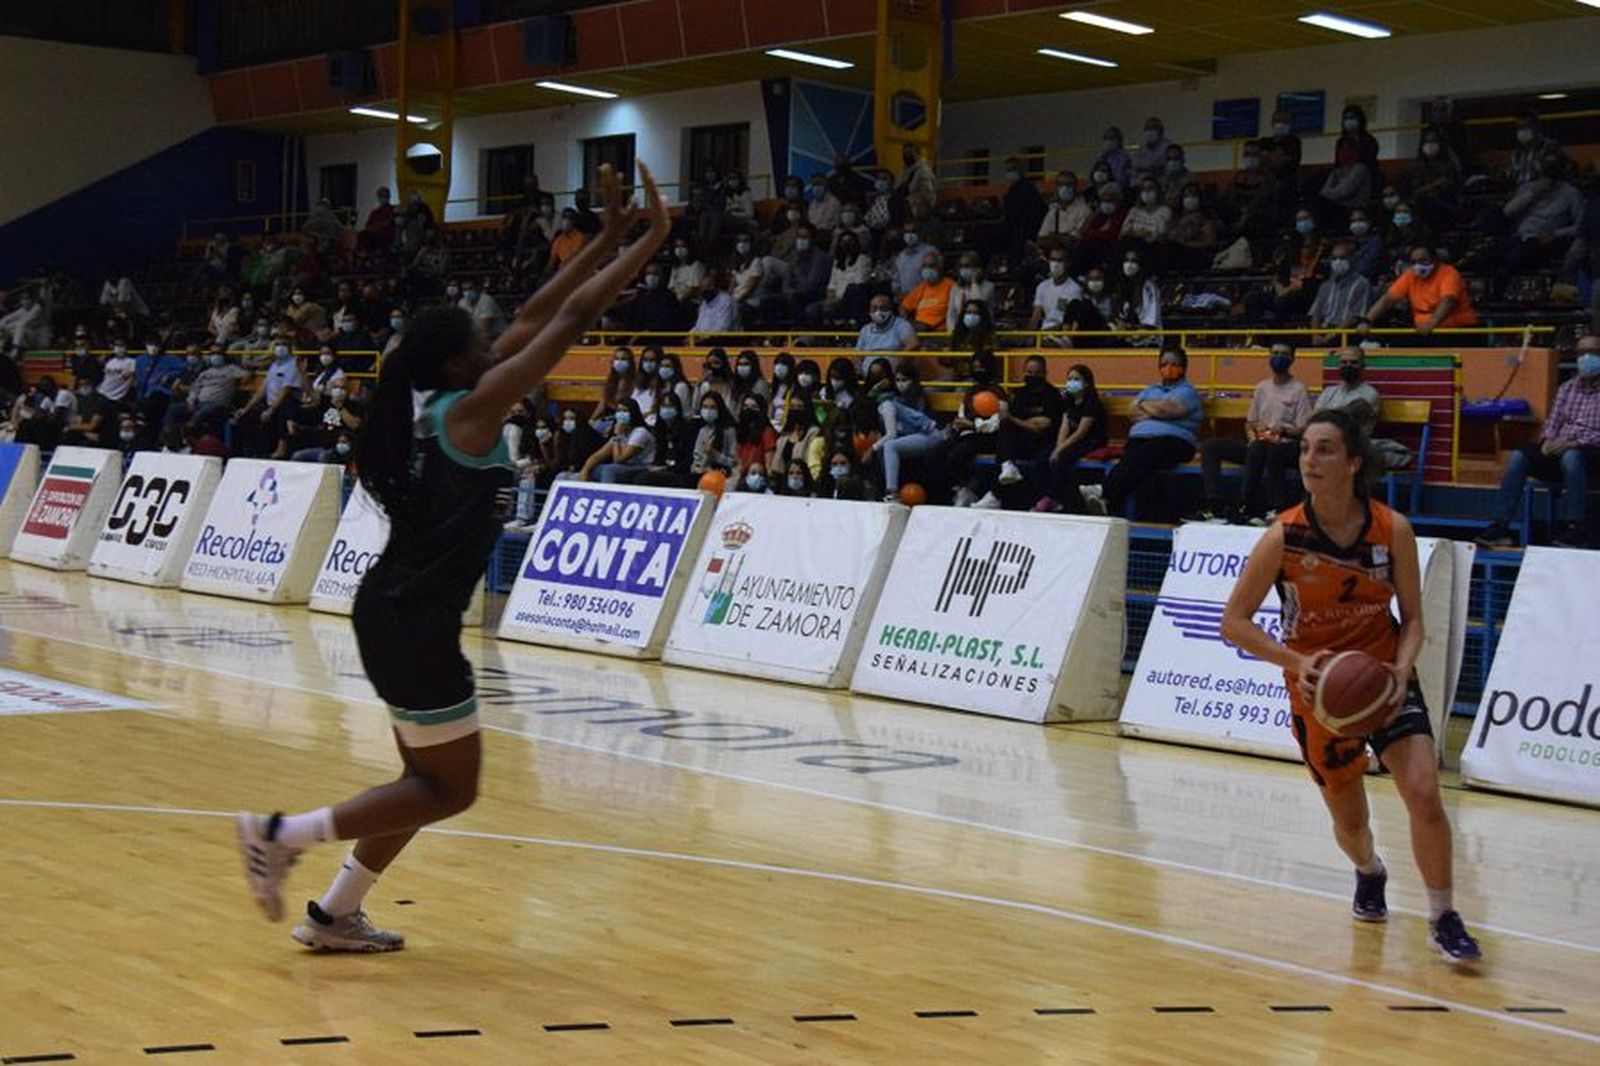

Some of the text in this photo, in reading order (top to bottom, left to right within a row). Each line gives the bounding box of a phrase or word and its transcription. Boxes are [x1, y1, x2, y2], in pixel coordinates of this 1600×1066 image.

[549, 495, 687, 535] ASESORIA
[195, 525, 285, 564] Recoletas
[531, 528, 671, 588] CONTA
[737, 574, 855, 611] AYUNTAMIENTO
[1340, 576, 1357, 603] 2
[727, 603, 843, 641] DE ZAMORA
[879, 625, 1045, 669] HERBI-PLAST, S.L.
[871, 652, 1039, 694] SEÑALIZACIONES
[1238, 706, 1268, 725] 993
